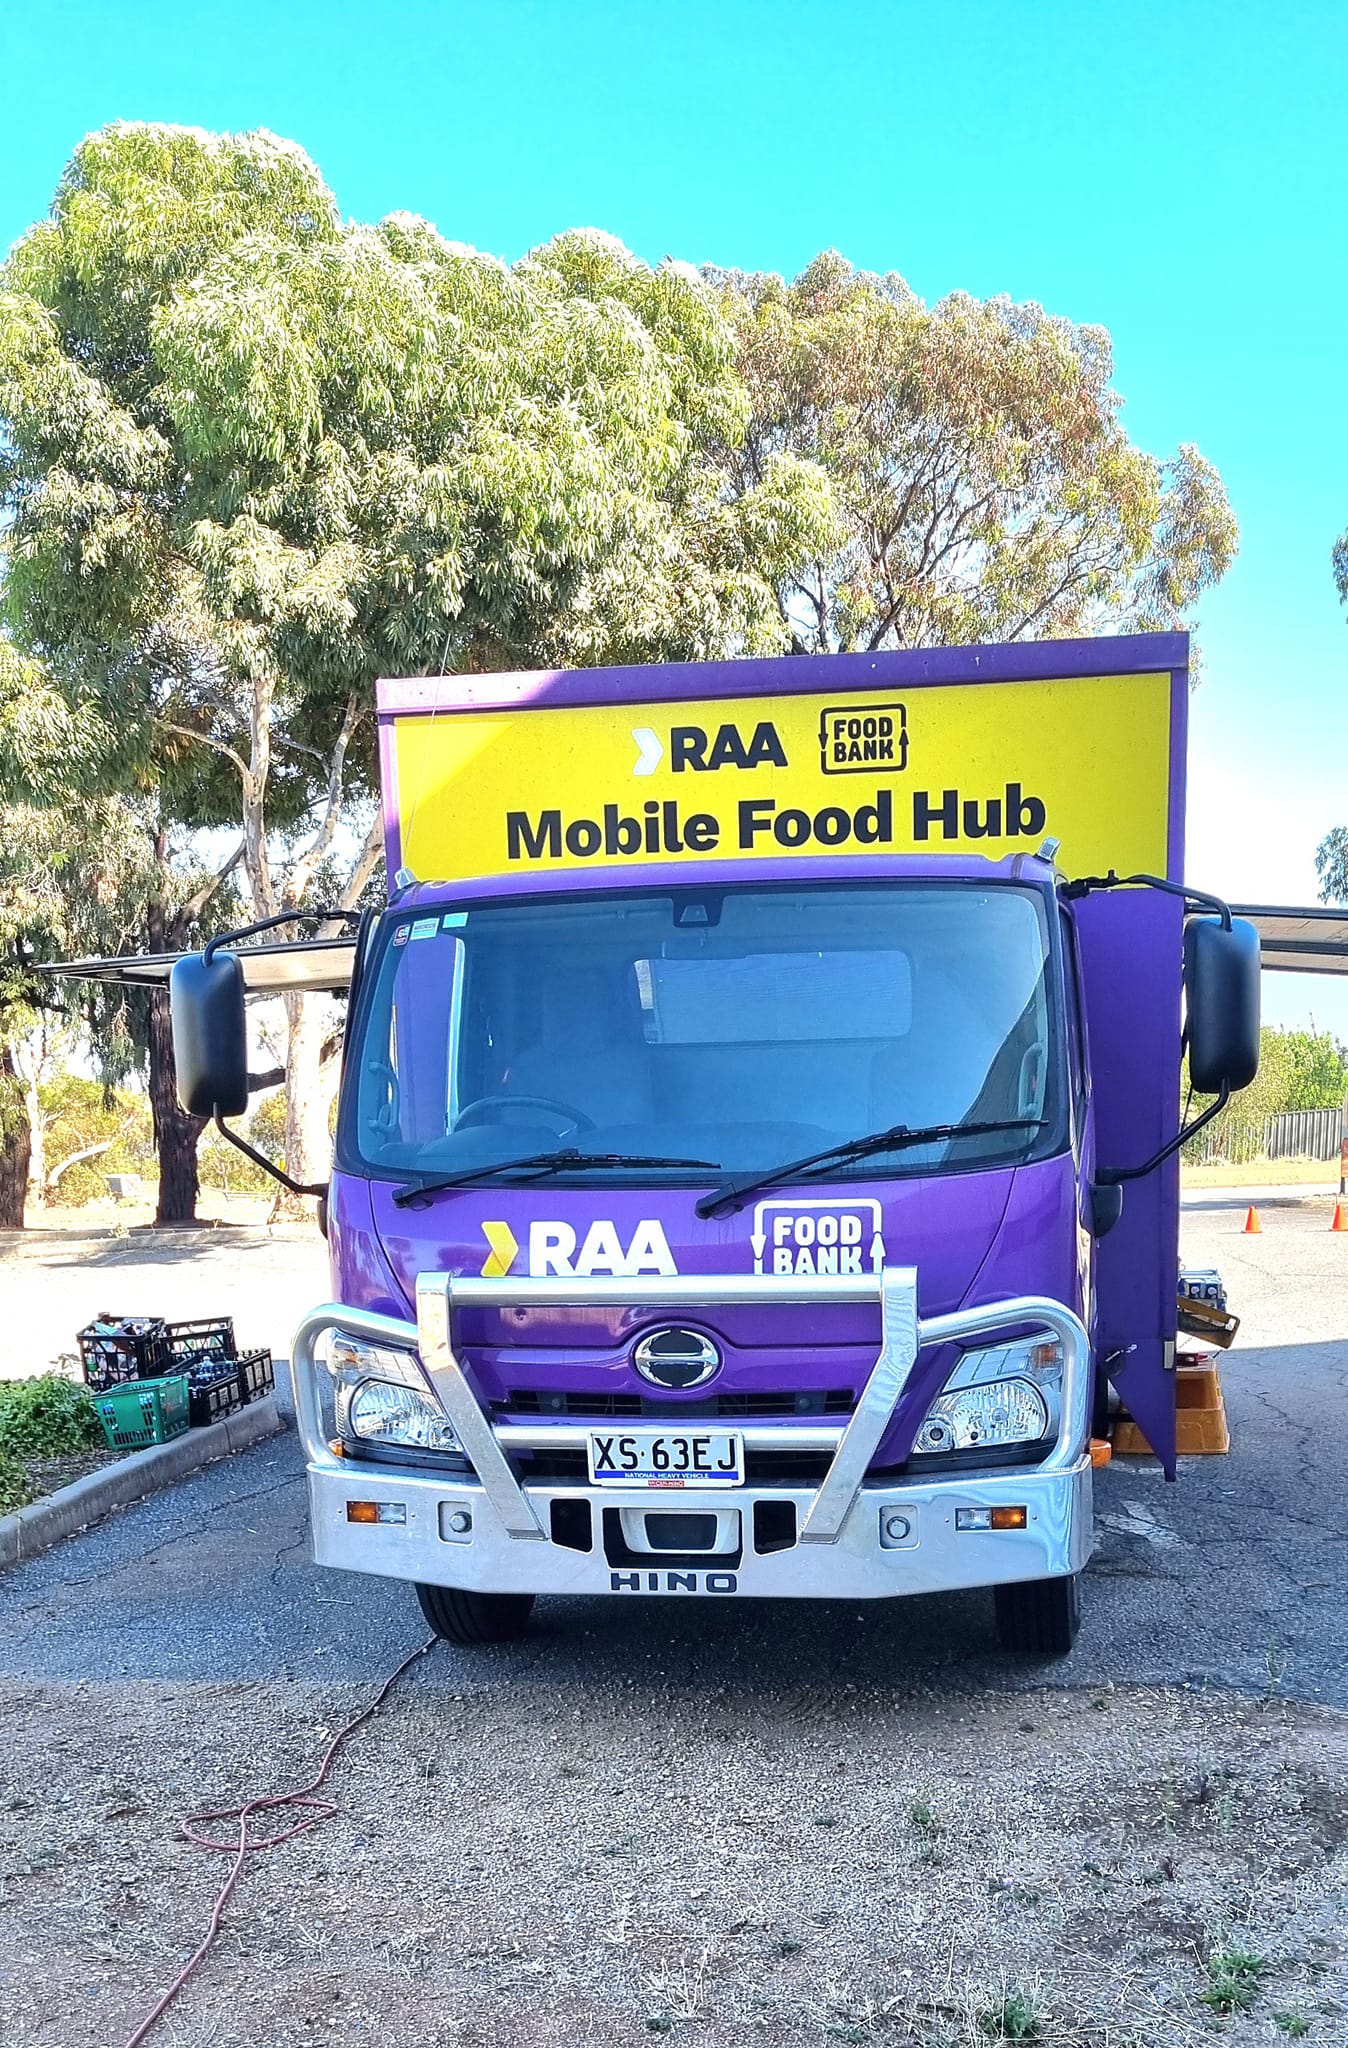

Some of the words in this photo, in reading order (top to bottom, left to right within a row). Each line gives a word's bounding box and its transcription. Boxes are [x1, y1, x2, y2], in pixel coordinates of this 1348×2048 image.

[832, 717, 894, 740] FOOD
[671, 722, 788, 772] RAA
[832, 738, 894, 763] BANK
[506, 800, 719, 859] Mobile
[737, 787, 893, 849] Food
[912, 783, 1046, 841] Hub
[773, 1215, 862, 1246] FOOD
[529, 1219, 678, 1276] RAA
[773, 1246, 863, 1275] BANK
[610, 1572, 738, 1593] HINO
